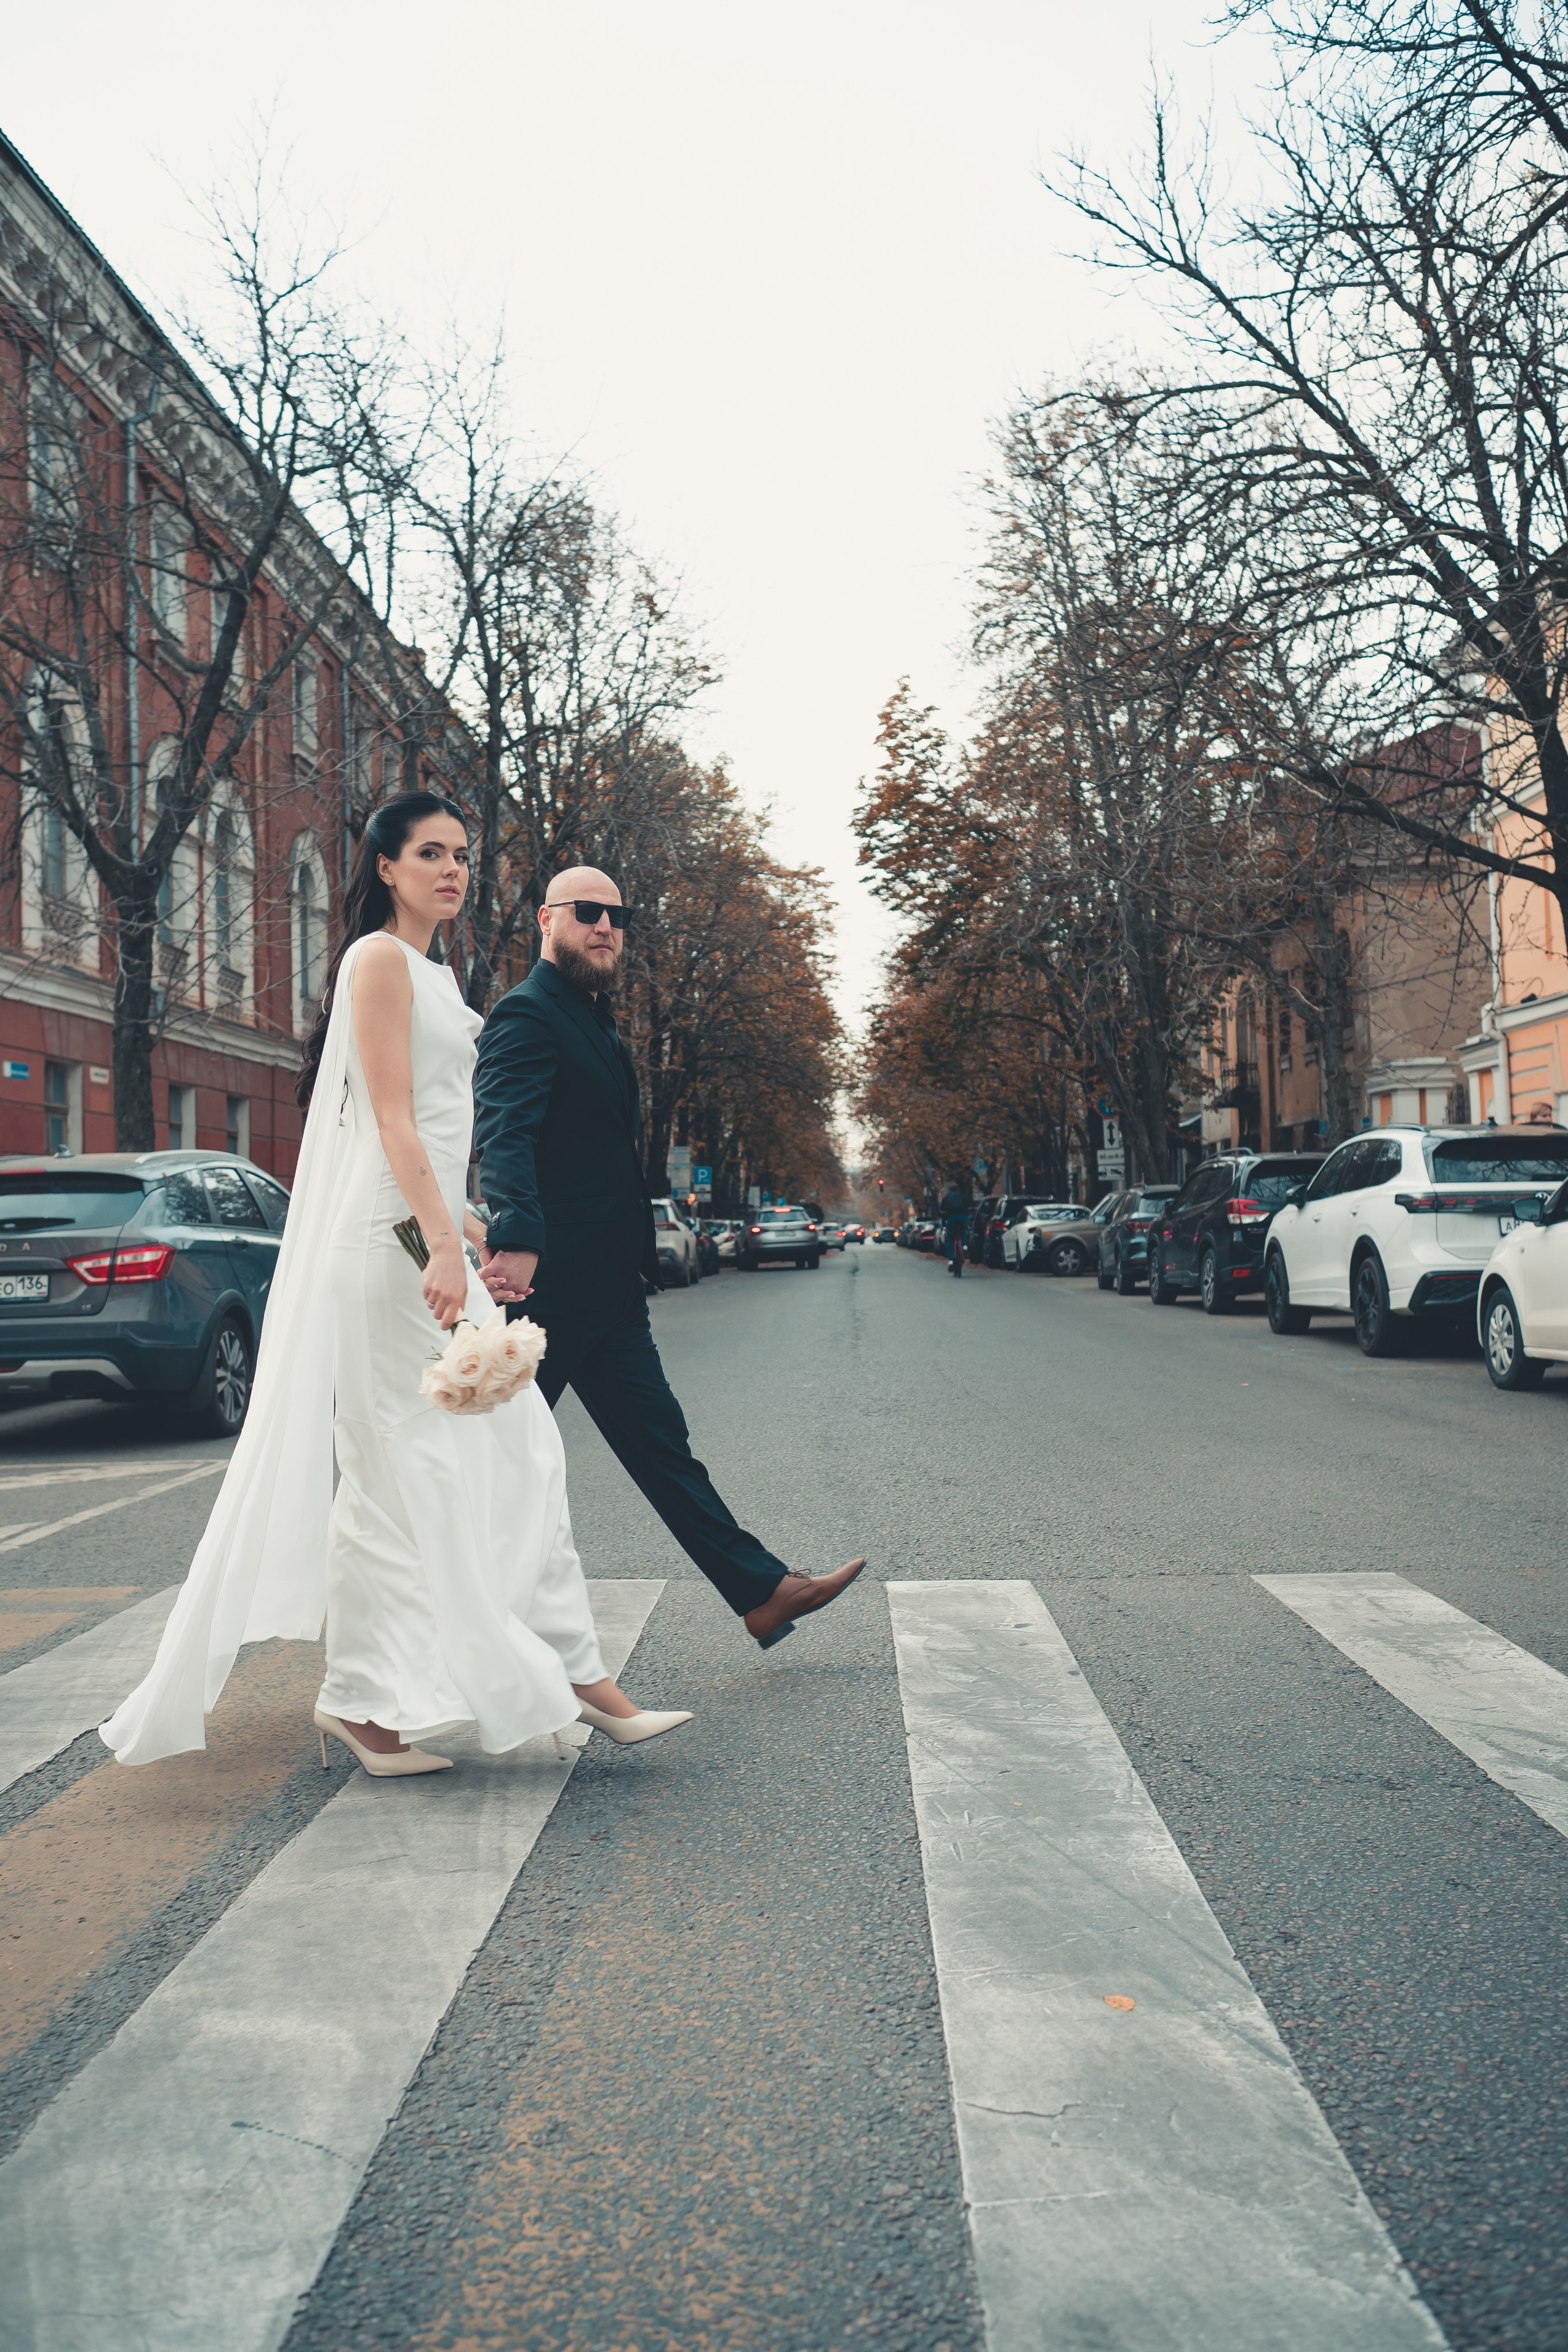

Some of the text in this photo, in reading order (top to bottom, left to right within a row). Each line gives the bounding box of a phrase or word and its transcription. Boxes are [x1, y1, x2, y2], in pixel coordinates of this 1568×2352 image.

[699, 1169, 707, 1182] P
[0, 1276, 43, 1295] О 136
